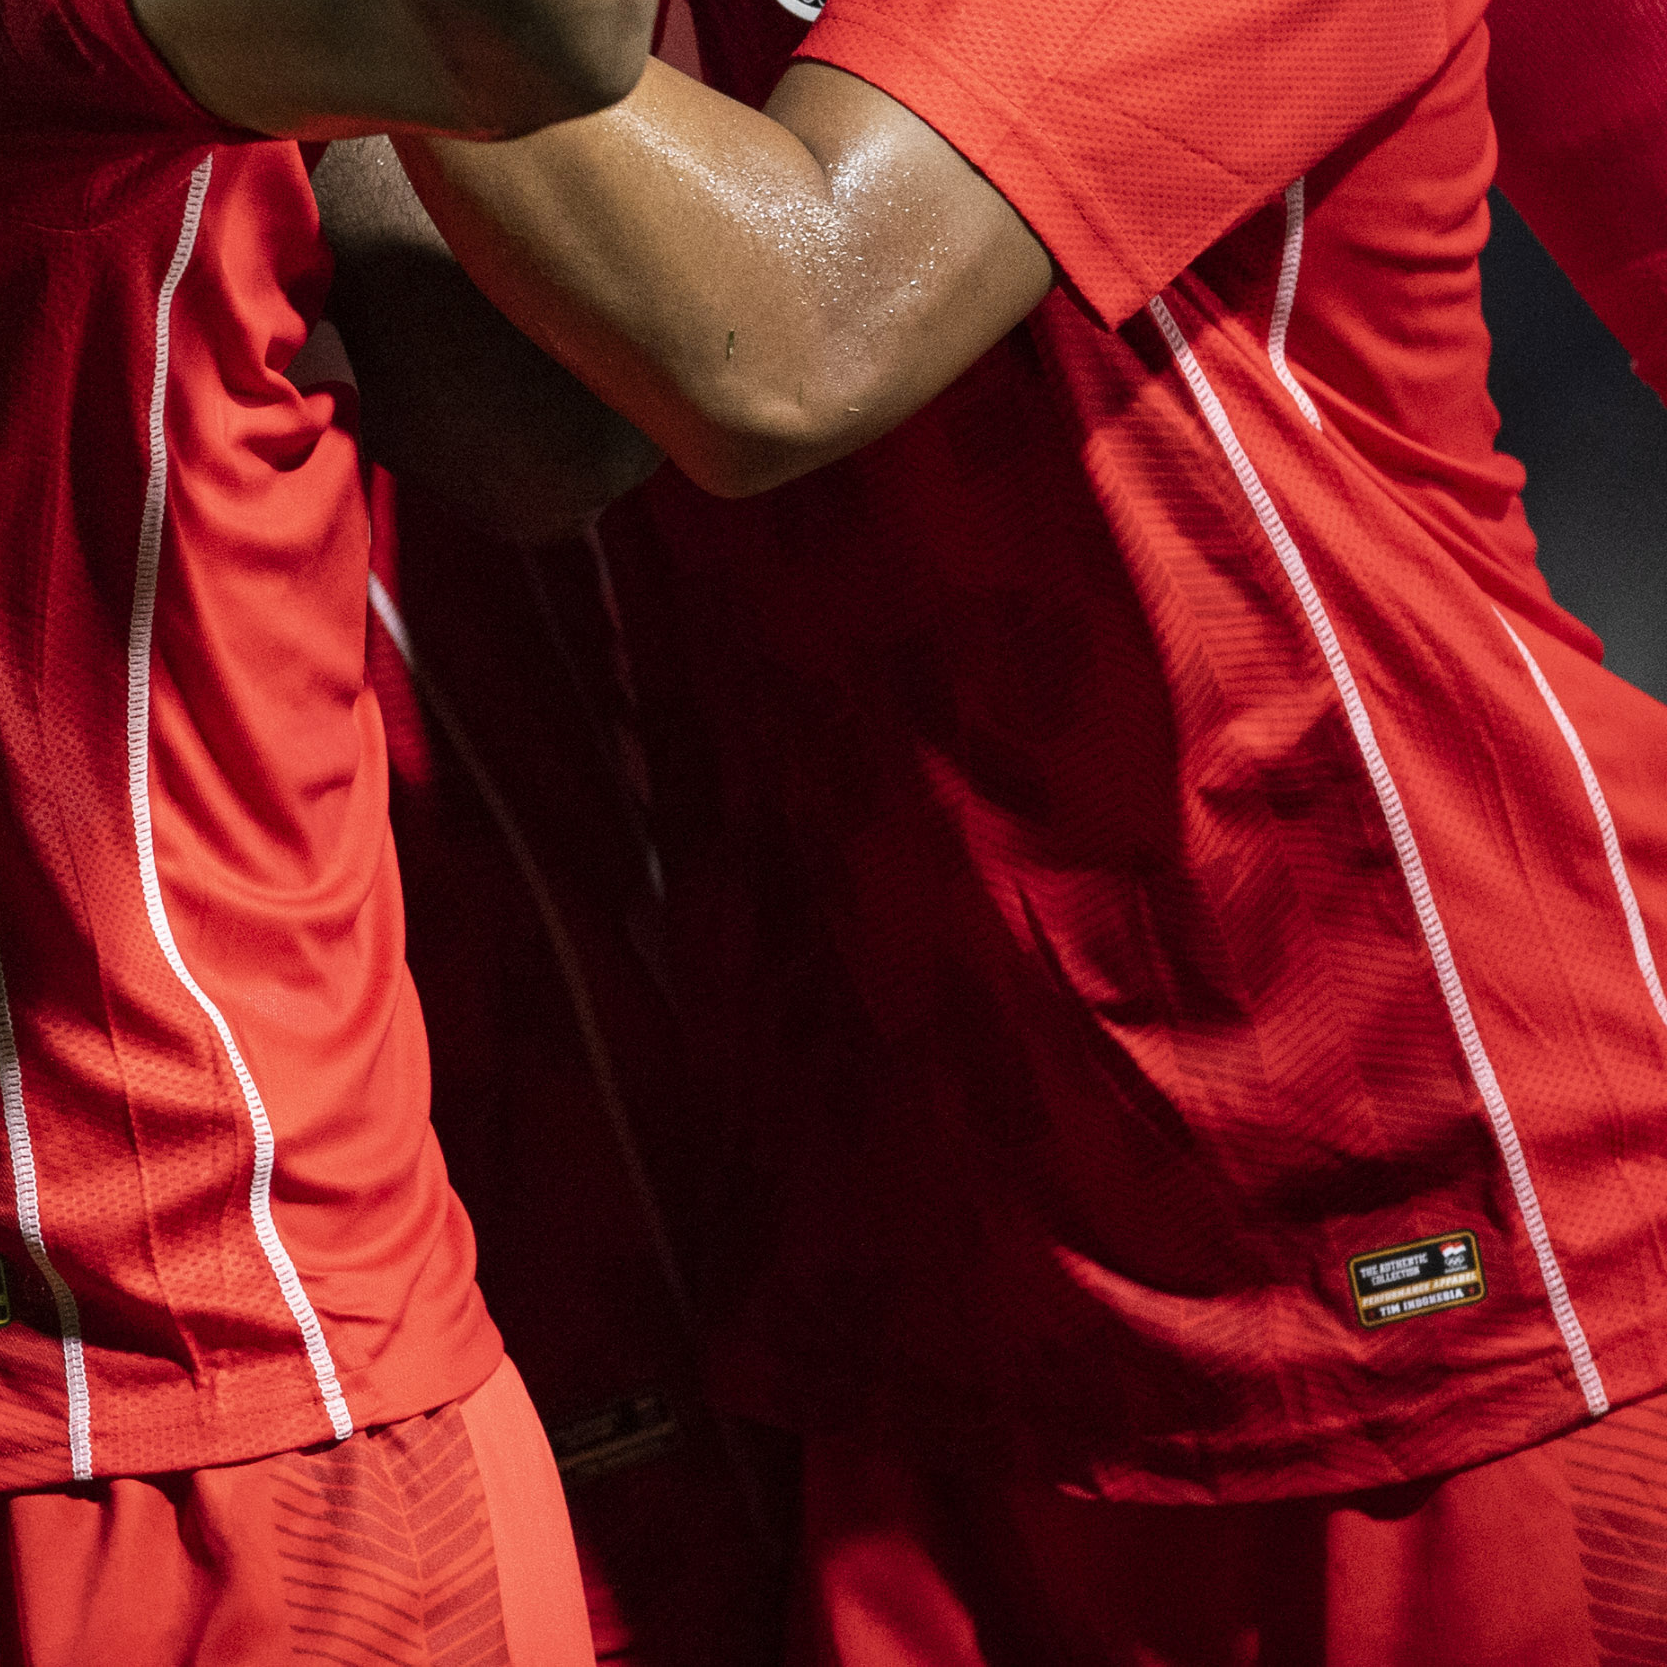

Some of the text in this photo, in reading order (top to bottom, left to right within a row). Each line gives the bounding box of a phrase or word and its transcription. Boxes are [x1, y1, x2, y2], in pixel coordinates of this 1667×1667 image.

[1360, 1264, 1379, 1279] THE
[1379, 1252, 1429, 1274] AUTHENTIC
[1371, 1266, 1421, 1286] COLLECTION
[1379, 1287, 1465, 1317] TIM INDONESIA
